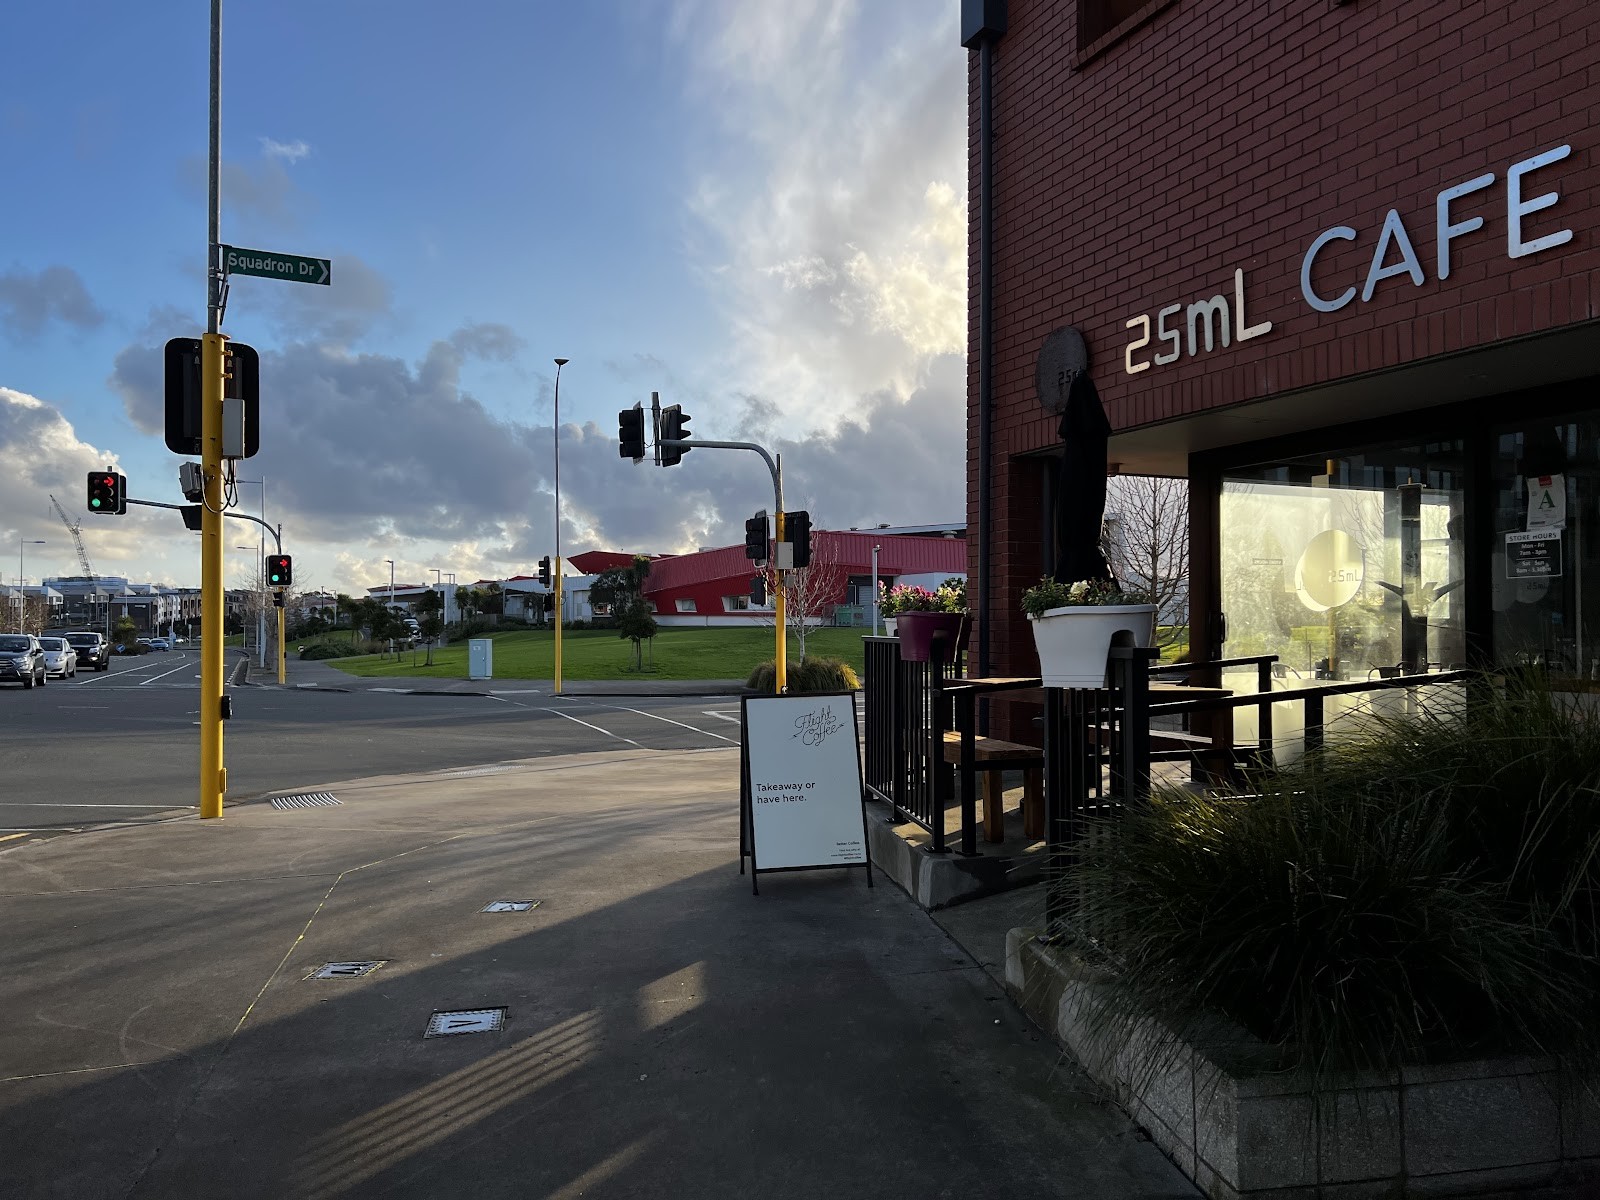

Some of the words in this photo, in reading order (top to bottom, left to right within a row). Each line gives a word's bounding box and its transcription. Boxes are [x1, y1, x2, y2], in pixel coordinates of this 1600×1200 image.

[228, 252, 294, 274] Squadron
[299, 261, 315, 276] Dr
[1125, 267, 1273, 375] 25mL
[1300, 144, 1574, 313] CAFE
[1538, 489, 1556, 510] A
[1509, 534, 1530, 542] STORE
[1532, 532, 1557, 540] HOURS
[795, 705, 836, 733] Flight
[802, 719, 841, 746] Coffee
[756, 782, 803, 792] Takeaway
[757, 795, 780, 804] have
[782, 794, 807, 802] here.
